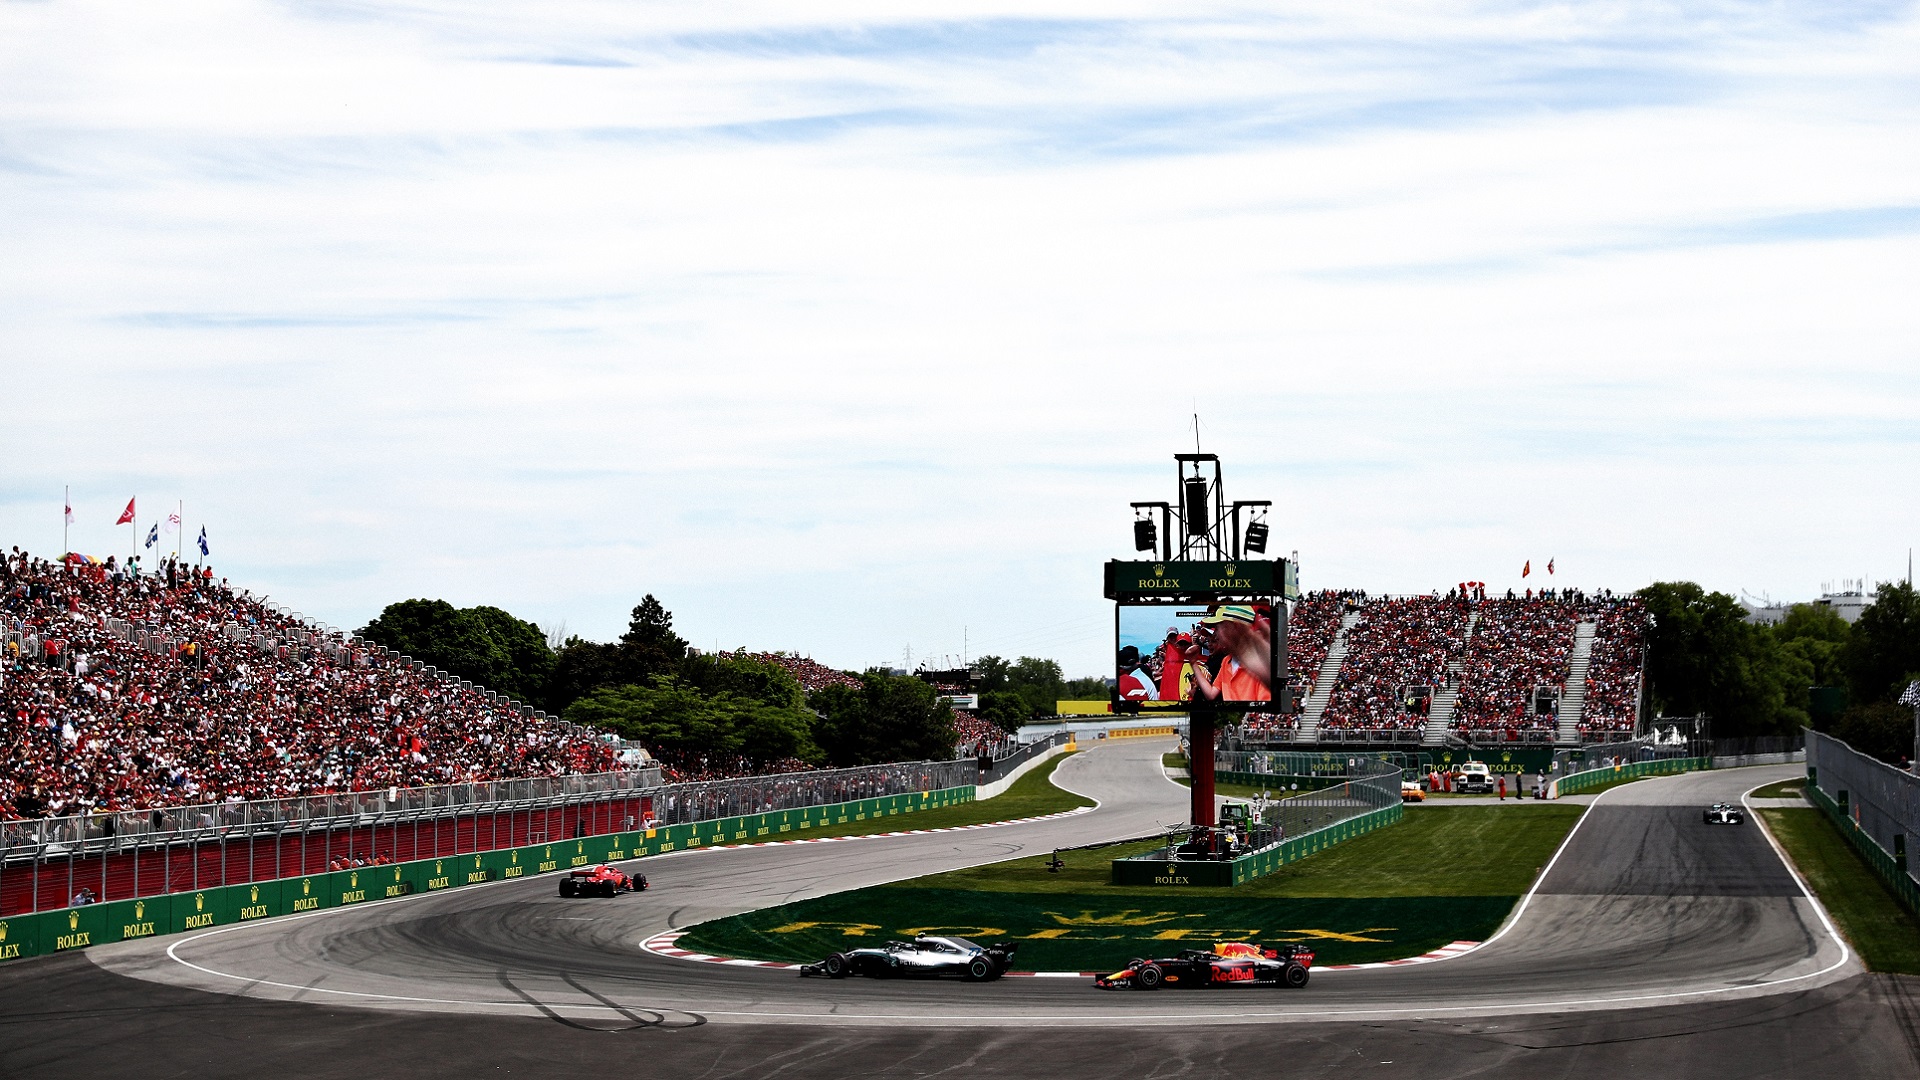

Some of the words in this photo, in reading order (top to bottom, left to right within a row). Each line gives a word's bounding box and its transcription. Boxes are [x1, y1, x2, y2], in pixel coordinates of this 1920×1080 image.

[1138, 579, 1180, 588] ROLEX
[1209, 579, 1251, 588] ROLEX
[1311, 763, 1344, 771] ROLEX
[1254, 814, 1260, 822] F
[660, 842, 675, 852] ROLEX
[687, 838, 701, 847] ROLEX
[571, 856, 588, 866] ROLEX
[608, 850, 625, 861] ROLEX
[505, 866, 523, 877] ROLEX
[539, 861, 557, 871] ROLEX
[429, 877, 449, 888] ROLEX
[468, 872, 487, 883] ROLEX
[1155, 876, 1189, 884] ROLEX
[386, 884, 408, 896] ROLEX
[342, 890, 365, 903] ROLEX
[294, 898, 318, 911] ROLEX
[241, 905, 267, 918] ROLEX
[185, 913, 214, 929] ROLEX
[123, 922, 155, 937] ROLEX
[56, 932, 91, 949] ROLEX
